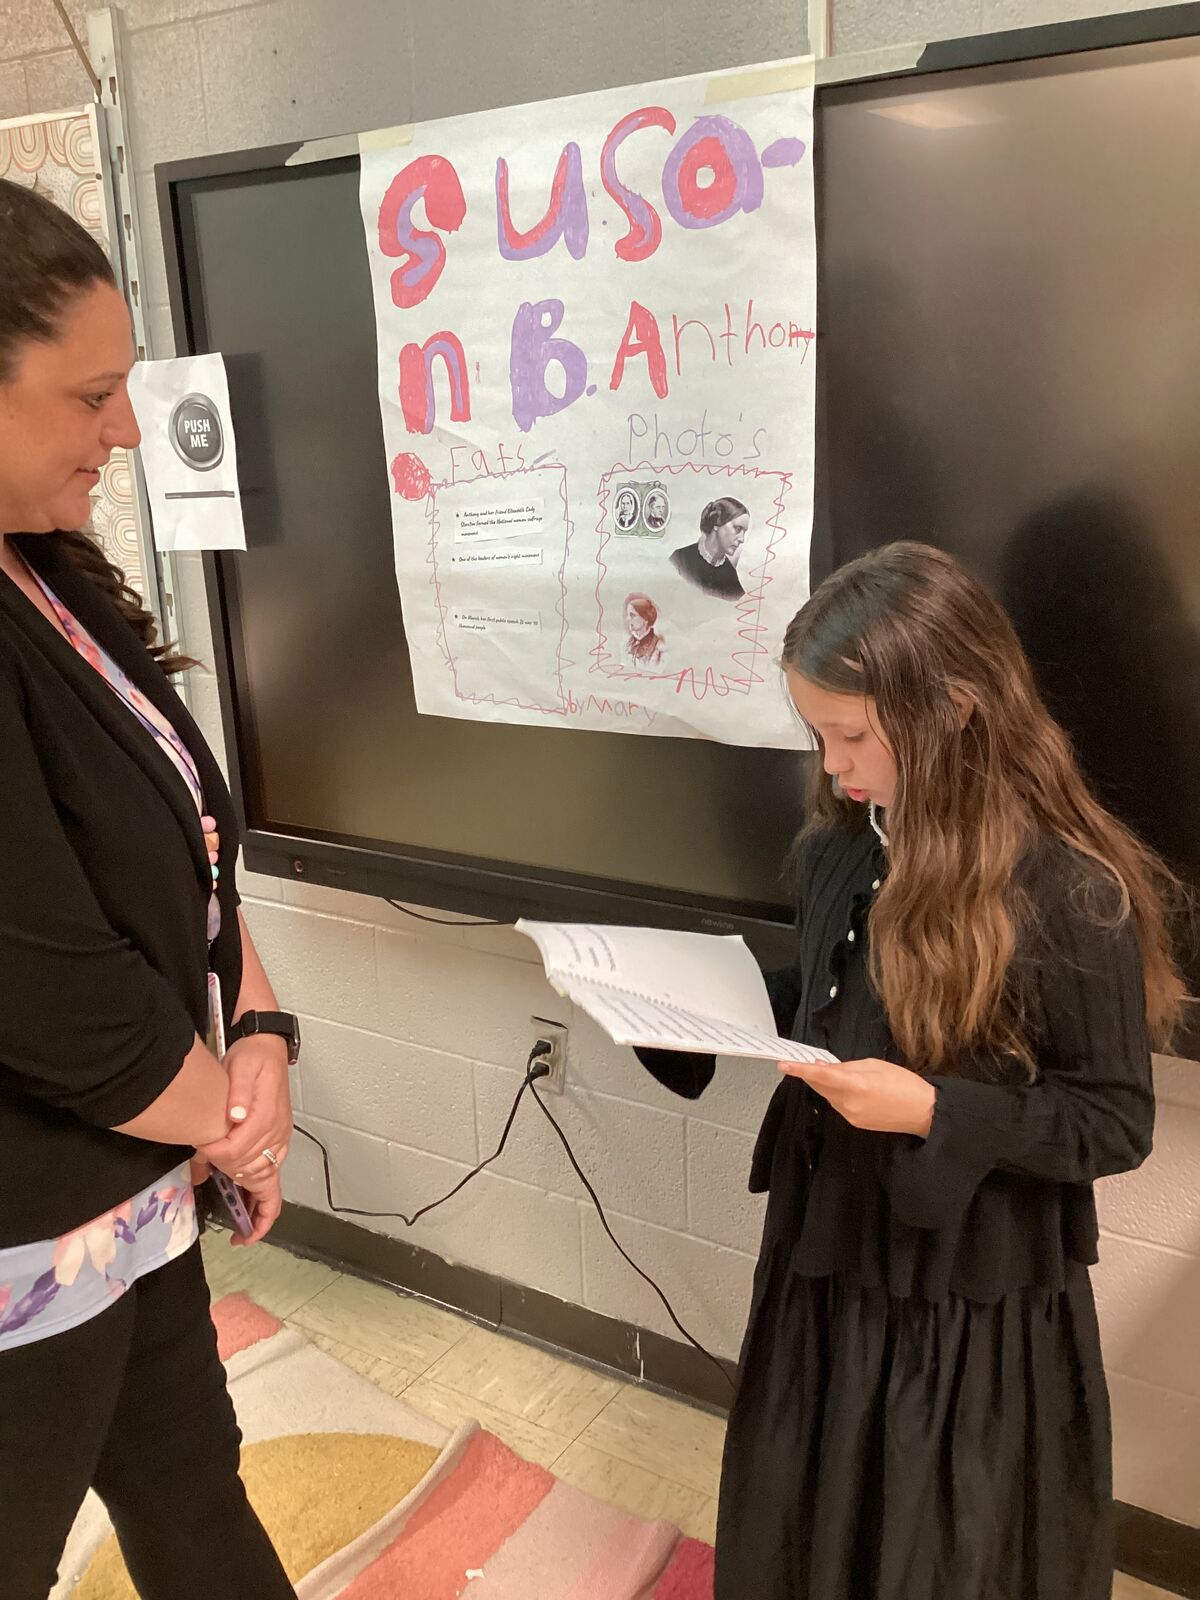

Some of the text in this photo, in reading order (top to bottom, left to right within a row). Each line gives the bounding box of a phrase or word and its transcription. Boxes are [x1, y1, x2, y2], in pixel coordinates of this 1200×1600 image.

[510, 298, 597, 432] B.
[609, 299, 815, 399] Anthony
[184, 418, 211, 433] PUSH
[190, 434, 209, 448] ME
[627, 410, 768, 465] Photo's
[527, 515, 542, 523] suffrage
